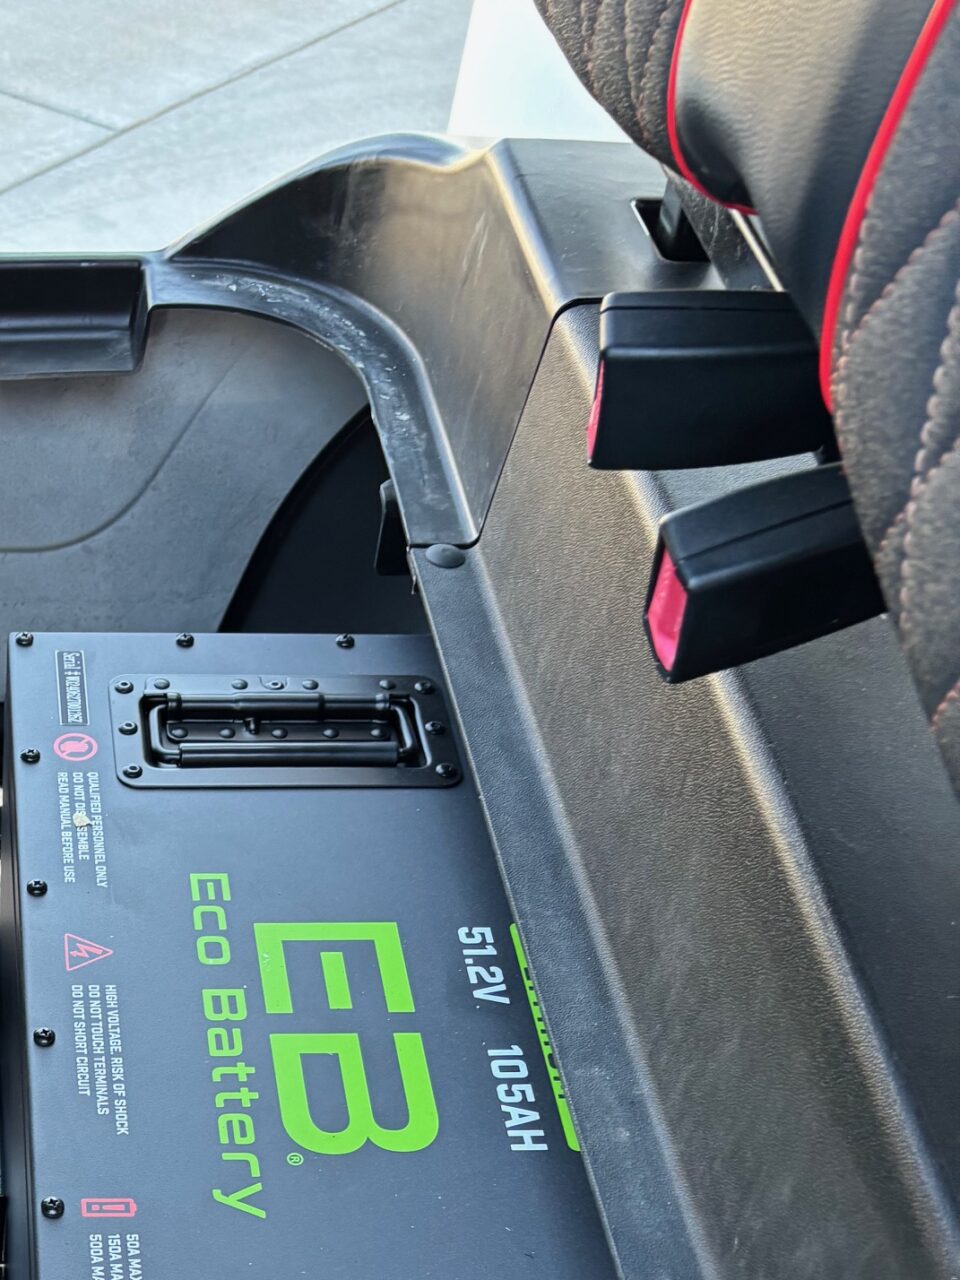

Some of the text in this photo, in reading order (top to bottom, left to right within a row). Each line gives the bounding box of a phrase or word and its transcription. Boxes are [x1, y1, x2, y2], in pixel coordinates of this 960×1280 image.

[63, 653, 81, 670] Serial
[57, 772, 75, 882] READ MANUAL BEFORE USE
[72, 772, 89, 860] DO NOT DISSEMBLE
[88, 772, 108, 888] QUALIFIED PERSONNEL ONLY
[105, 985, 117, 1007] HIGH
[71, 985, 90, 1096] DO NOT SHORT CIRCUIT
[88, 985, 109, 1115] DO NOT TOUCH TERMINALS
[189, 872, 266, 1218] Eco Battery
[458, 926, 510, 1004] 51.2V
[487, 1045, 549, 1151] 105AH
[110, 1058, 124, 1080] RISK
[113, 1083, 125, 1096] OF
[115, 1099, 129, 1135] SHOCK
[89, 1234, 104, 1263] 500A
[108, 1234, 122, 1261] 150A
[126, 1234, 140, 1256] 50A
